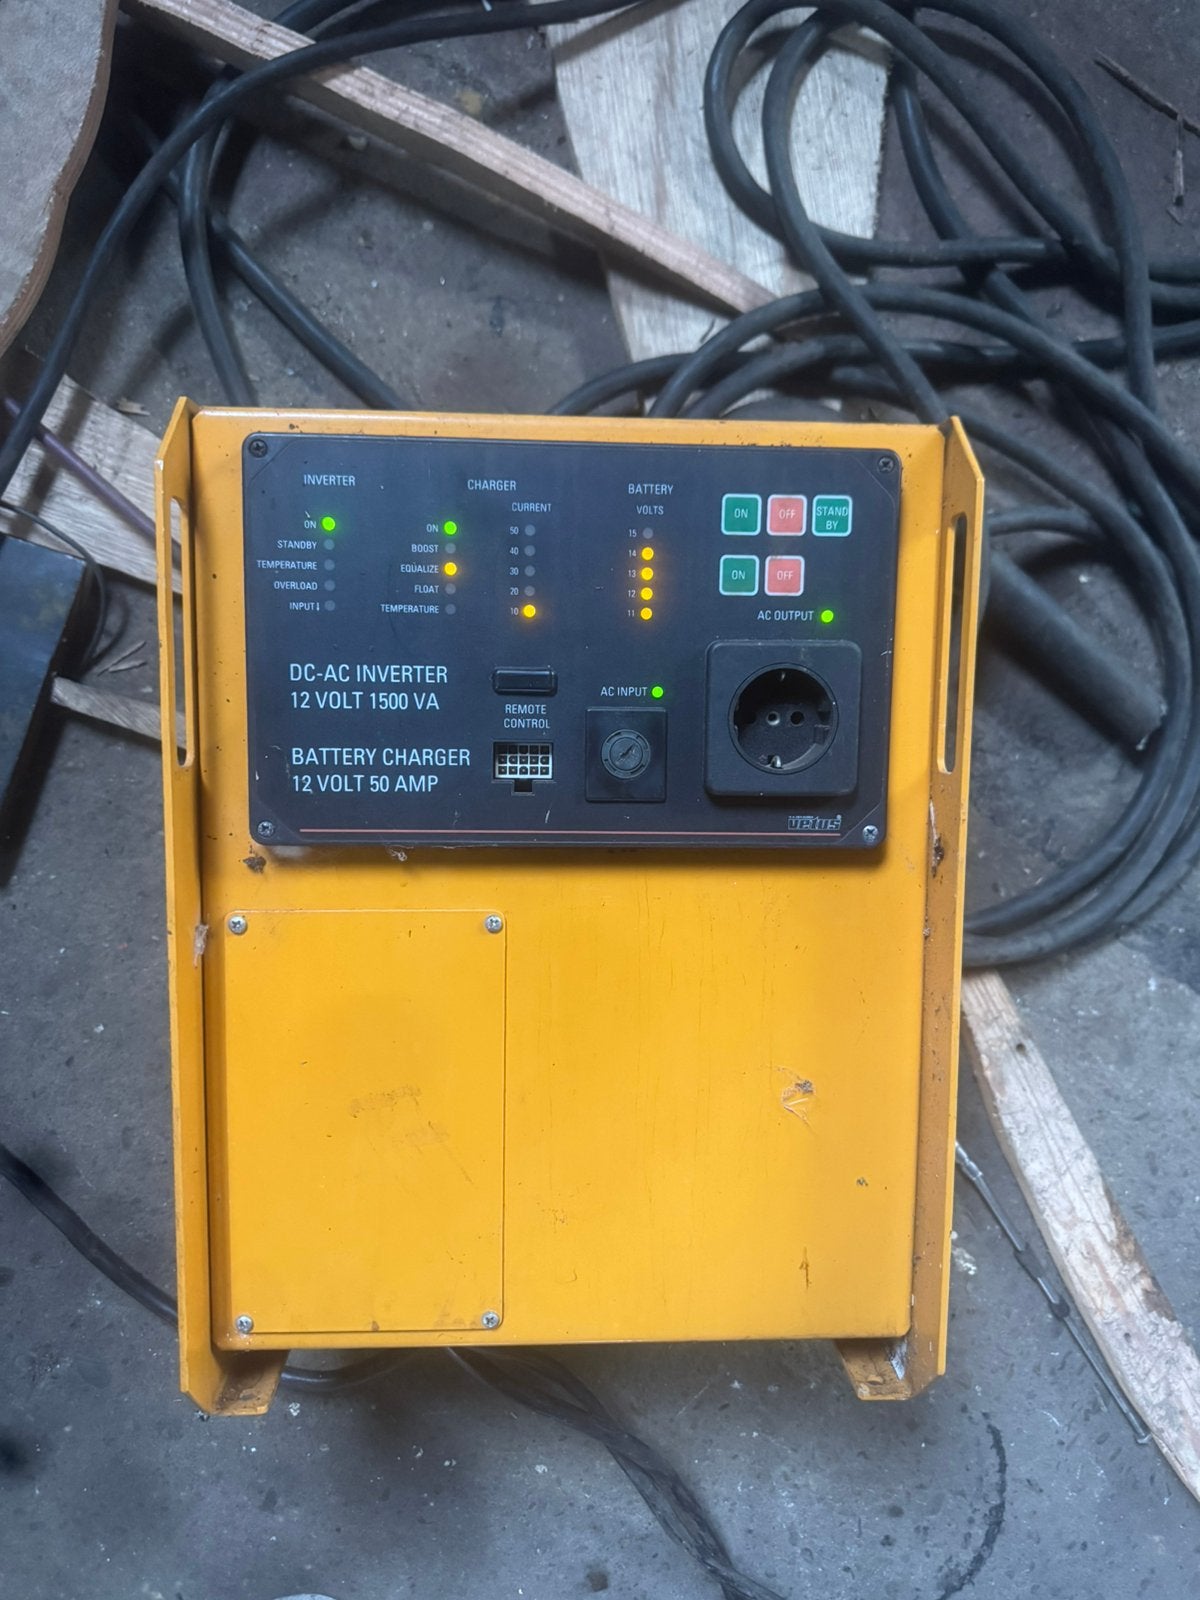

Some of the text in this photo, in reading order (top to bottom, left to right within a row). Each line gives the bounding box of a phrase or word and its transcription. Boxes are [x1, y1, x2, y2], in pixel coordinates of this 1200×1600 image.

[303, 474, 356, 487] INVERTER
[467, 479, 517, 491] CHARGER
[628, 483, 674, 495] BATTERY
[511, 502, 552, 513] CURRENT
[636, 505, 664, 515] VOLTS
[816, 506, 848, 517] STAND
[734, 508, 748, 519] ON
[779, 509, 796, 520] OFF
[304, 520, 317, 529] ON
[426, 523, 439, 533] ON
[509, 525, 519, 535] 50
[825, 520, 839, 531] BY
[628, 528, 637, 538] 15
[277, 540, 317, 550] STANDBY
[411, 544, 439, 553] BOOST
[509, 546, 519, 556] 40
[628, 548, 637, 558] 14
[256, 559, 318, 571] TEMPERATURE
[400, 563, 439, 574] EQUALIZE
[509, 566, 519, 576] 30
[628, 569, 637, 578] 13
[731, 569, 746, 580] ON
[776, 570, 794, 581] OFF
[273, 580, 318, 590] OVERLOAD
[414, 584, 439, 594] FLOAT
[509, 586, 519, 596] 20
[627, 589, 636, 598] 12
[289, 602, 314, 611] INPUT
[380, 603, 440, 614] TEMPERATURE
[510, 606, 519, 616] 10
[627, 609, 635, 617] 11
[757, 610, 815, 621] AC OUTPUT
[289, 663, 448, 684] DC-AC INVERTER
[600, 687, 648, 697] AC INPUT
[290, 691, 440, 710] 12 VOLT 1500 VA
[505, 704, 547, 715] REMOTE
[503, 718, 551, 729] CONTROL
[291, 747, 471, 766] BATTERY CHARGER
[292, 775, 439, 793] 12 VOLT 50 AMP
